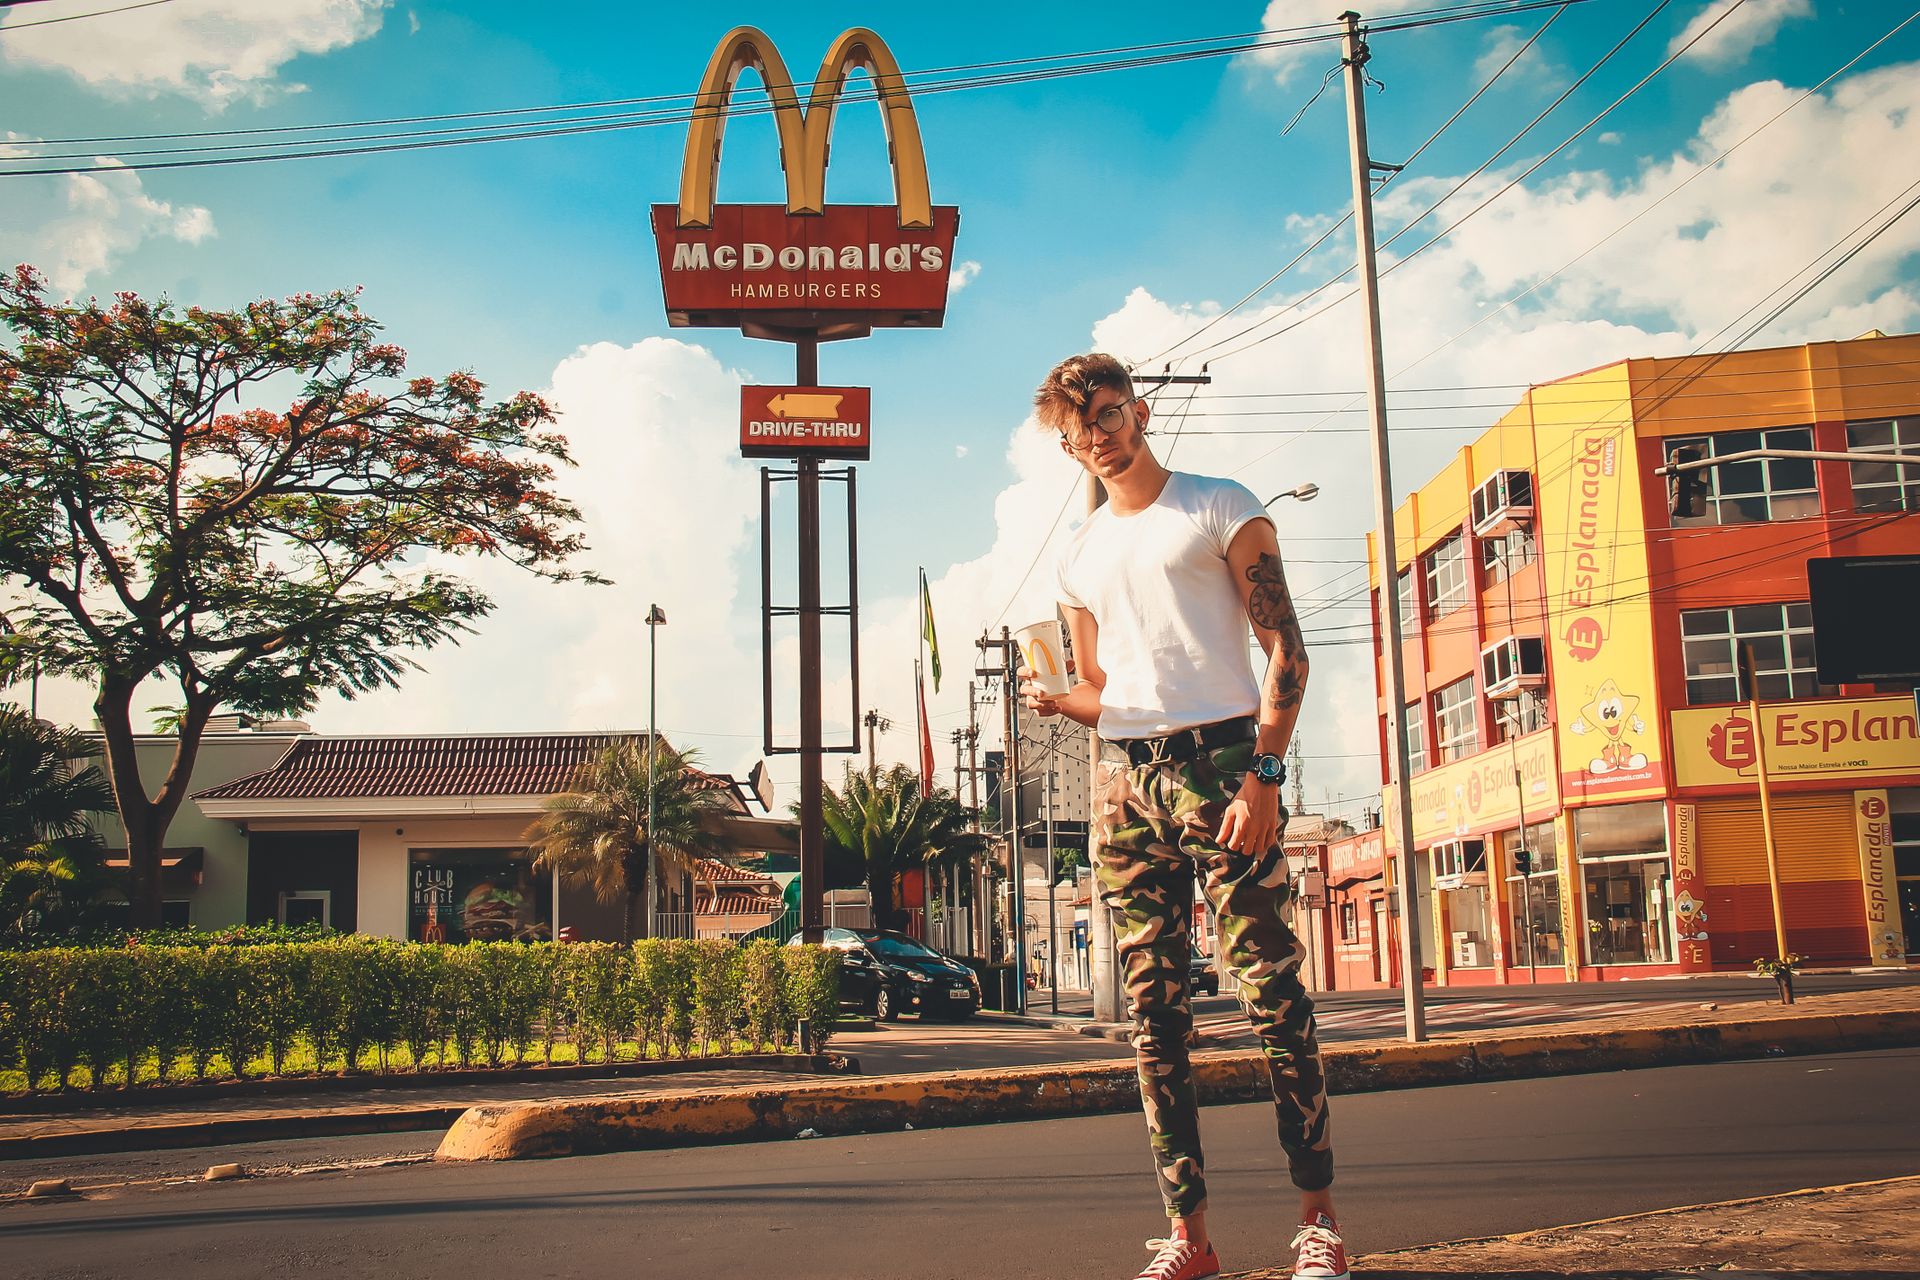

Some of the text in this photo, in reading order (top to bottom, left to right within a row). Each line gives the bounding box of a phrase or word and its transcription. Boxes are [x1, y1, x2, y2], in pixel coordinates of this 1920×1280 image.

[672, 242, 944, 272] McDonald's
[731, 283, 882, 298] HAMBURGERS
[749, 421, 862, 438] DRIVE-THRU
[1568, 437, 1602, 609] Esplanada
[1678, 807, 1690, 867] Esplanada
[415, 869, 454, 889] CLUB
[1864, 822, 1888, 923] Esplanada
[414, 890, 453, 904] HOUSE
